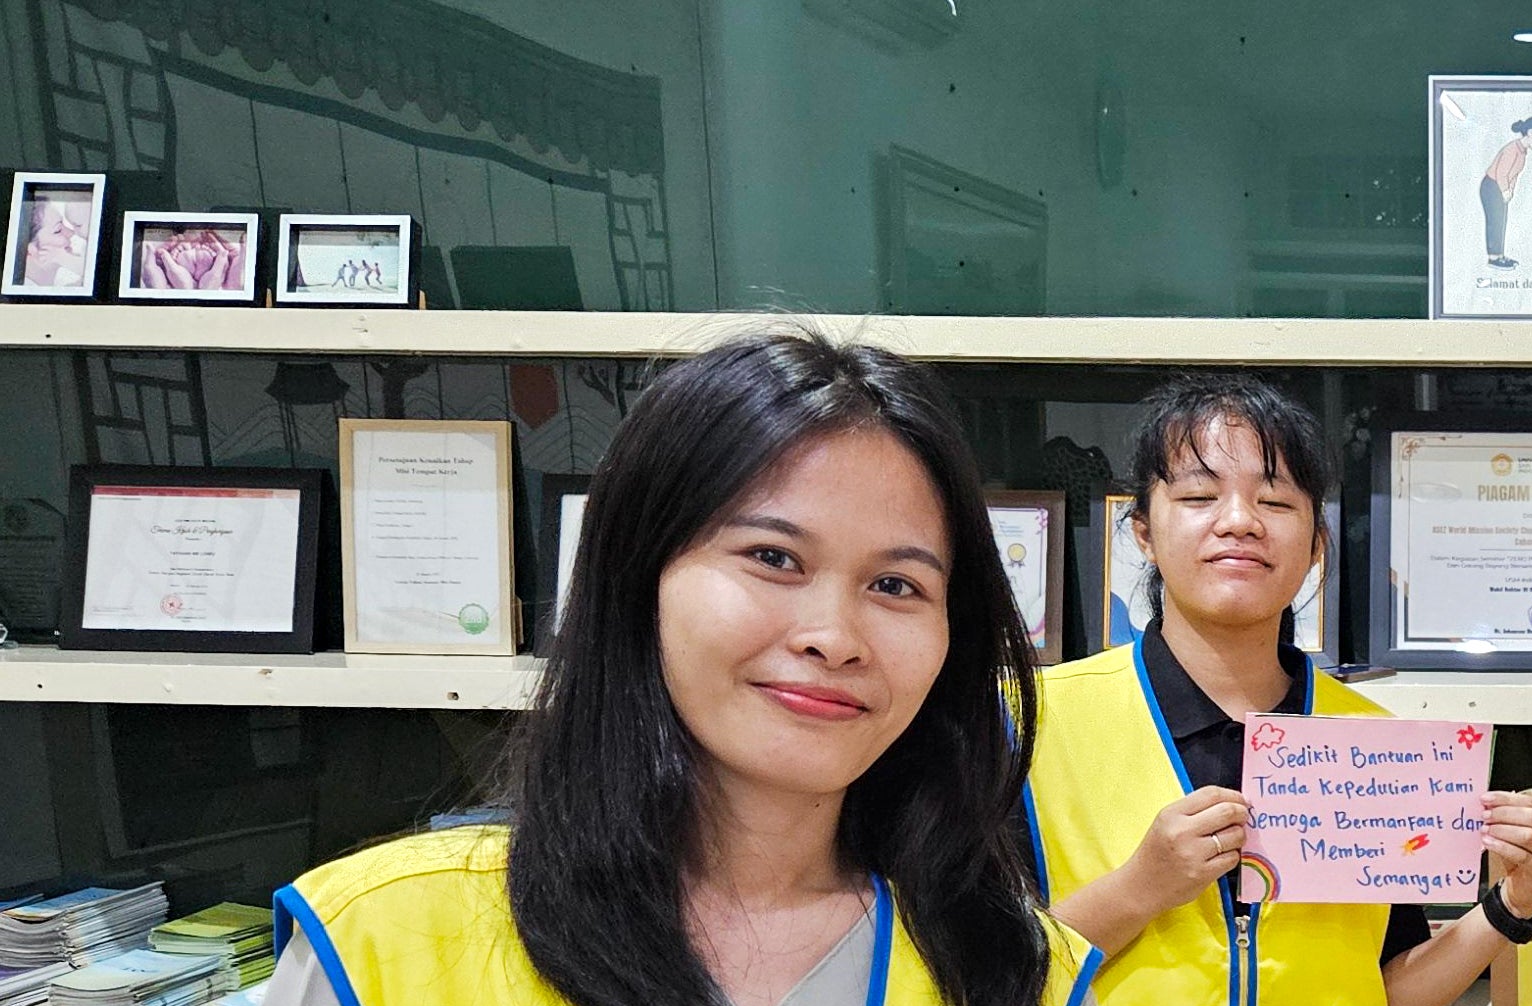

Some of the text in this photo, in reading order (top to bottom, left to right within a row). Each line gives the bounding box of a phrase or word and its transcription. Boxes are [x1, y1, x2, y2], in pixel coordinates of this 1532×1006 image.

[1476, 278, 1519, 290] Slamat
[1478, 485, 1530, 502] PIAGAM
[1268, 744, 1338, 769] Sedikit
[1351, 746, 1424, 769] Bantuan
[1253, 775, 1310, 799] Tanda
[1319, 777, 1419, 798] Kepedulian
[1248, 806, 1322, 833] Semoga
[1300, 838, 1386, 863] Memberi
[1356, 865, 1451, 895] Semangat
